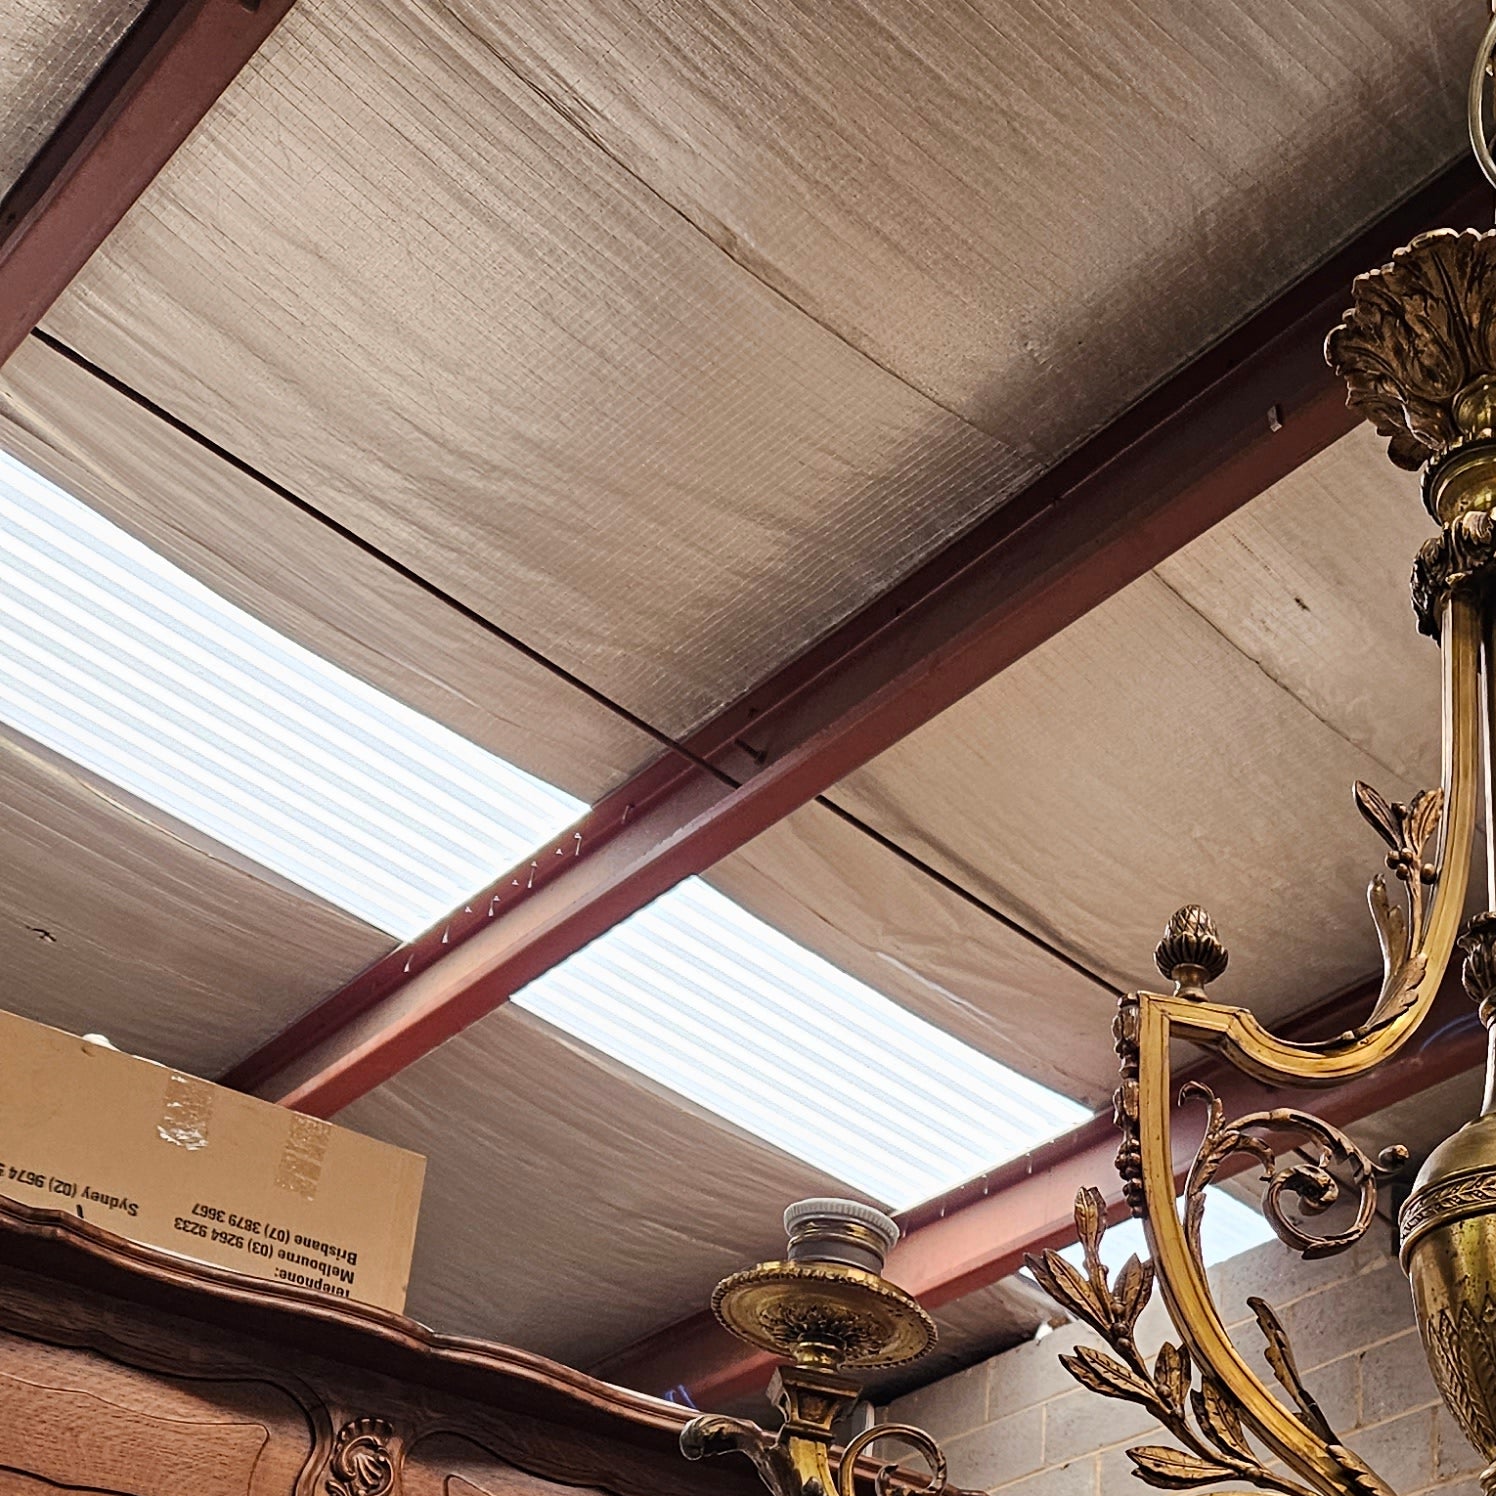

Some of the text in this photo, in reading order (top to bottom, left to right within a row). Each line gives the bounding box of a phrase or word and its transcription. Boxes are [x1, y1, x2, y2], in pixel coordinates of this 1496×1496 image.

[8, 1166, 47, 1188] 9674
[49, 1176, 77, 1199] (02)
[81, 1186, 140, 1217] Sydney
[191, 1202, 358, 1266] Brisbane (07) 3879 3667
[174, 1216, 355, 1285] Melbourne (03) 9264 9233
